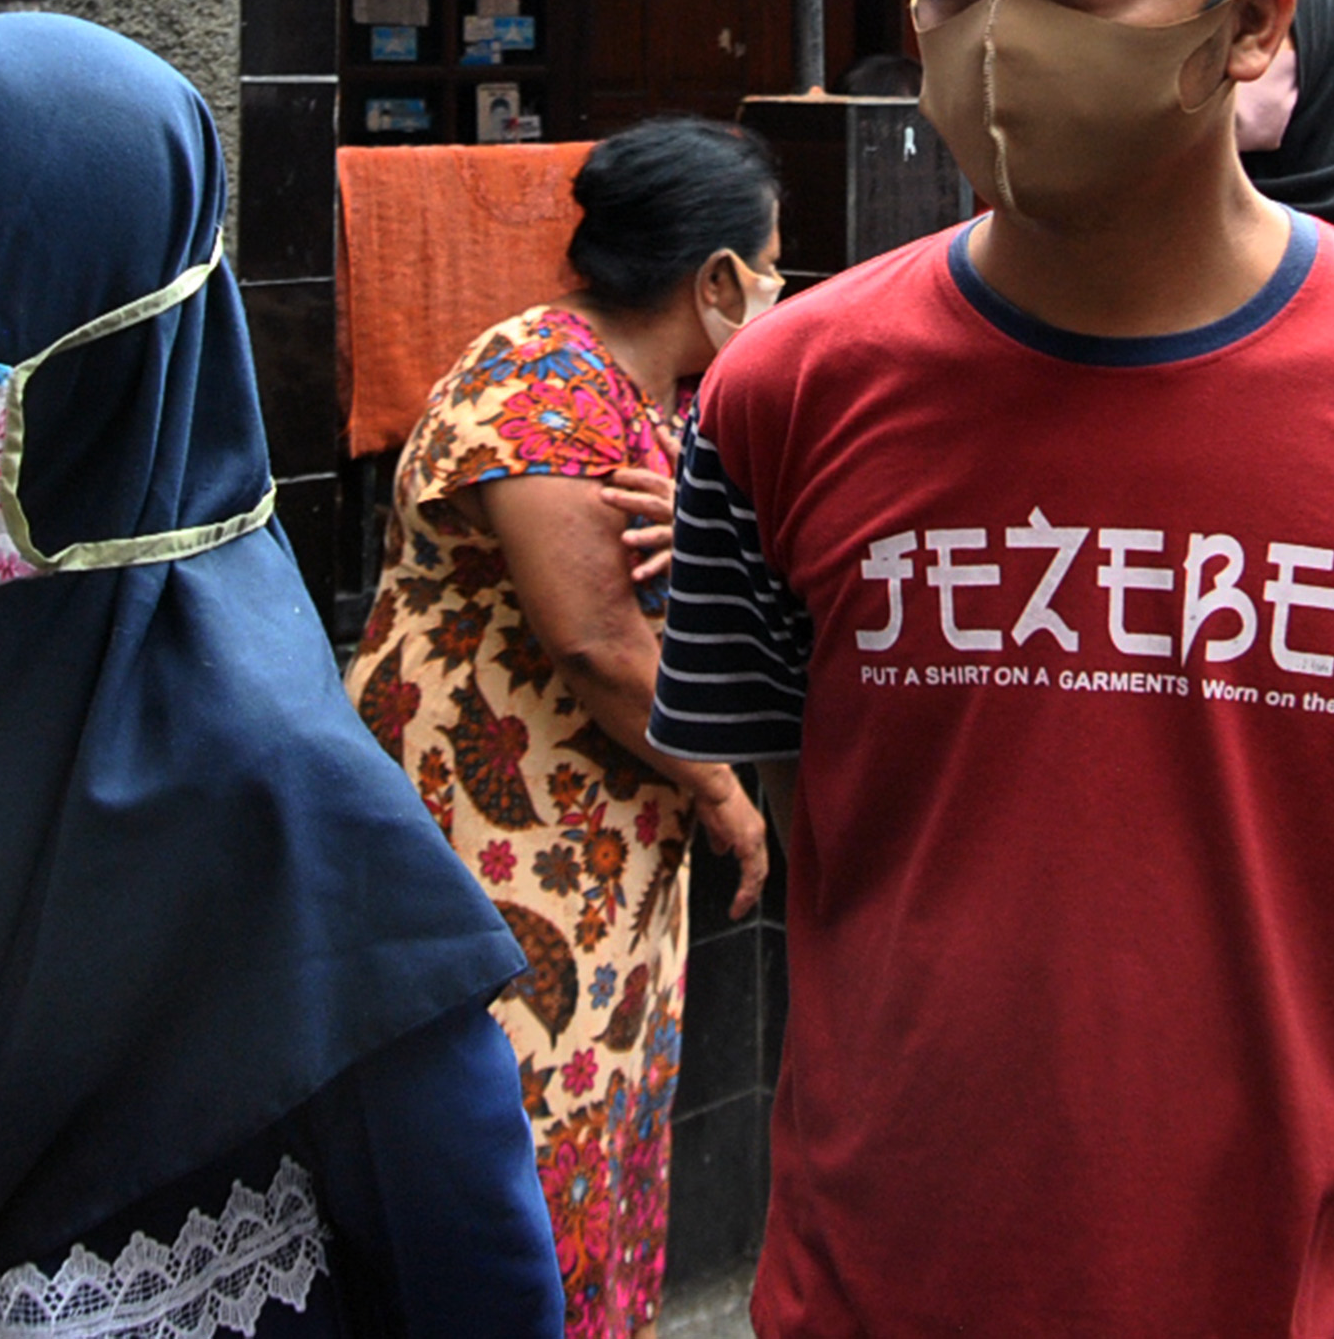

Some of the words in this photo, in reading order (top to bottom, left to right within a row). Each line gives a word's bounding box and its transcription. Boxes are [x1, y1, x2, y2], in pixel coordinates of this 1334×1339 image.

[860, 664, 899, 686] PUT
[903, 666, 921, 686] A
[924, 664, 992, 686] SHIRT
[993, 666, 1030, 686] ON
[1034, 666, 1051, 687] A
[1058, 669, 1190, 696] GARMENTS
[1200, 679, 1259, 703] Worn
[1264, 688, 1297, 709] on
